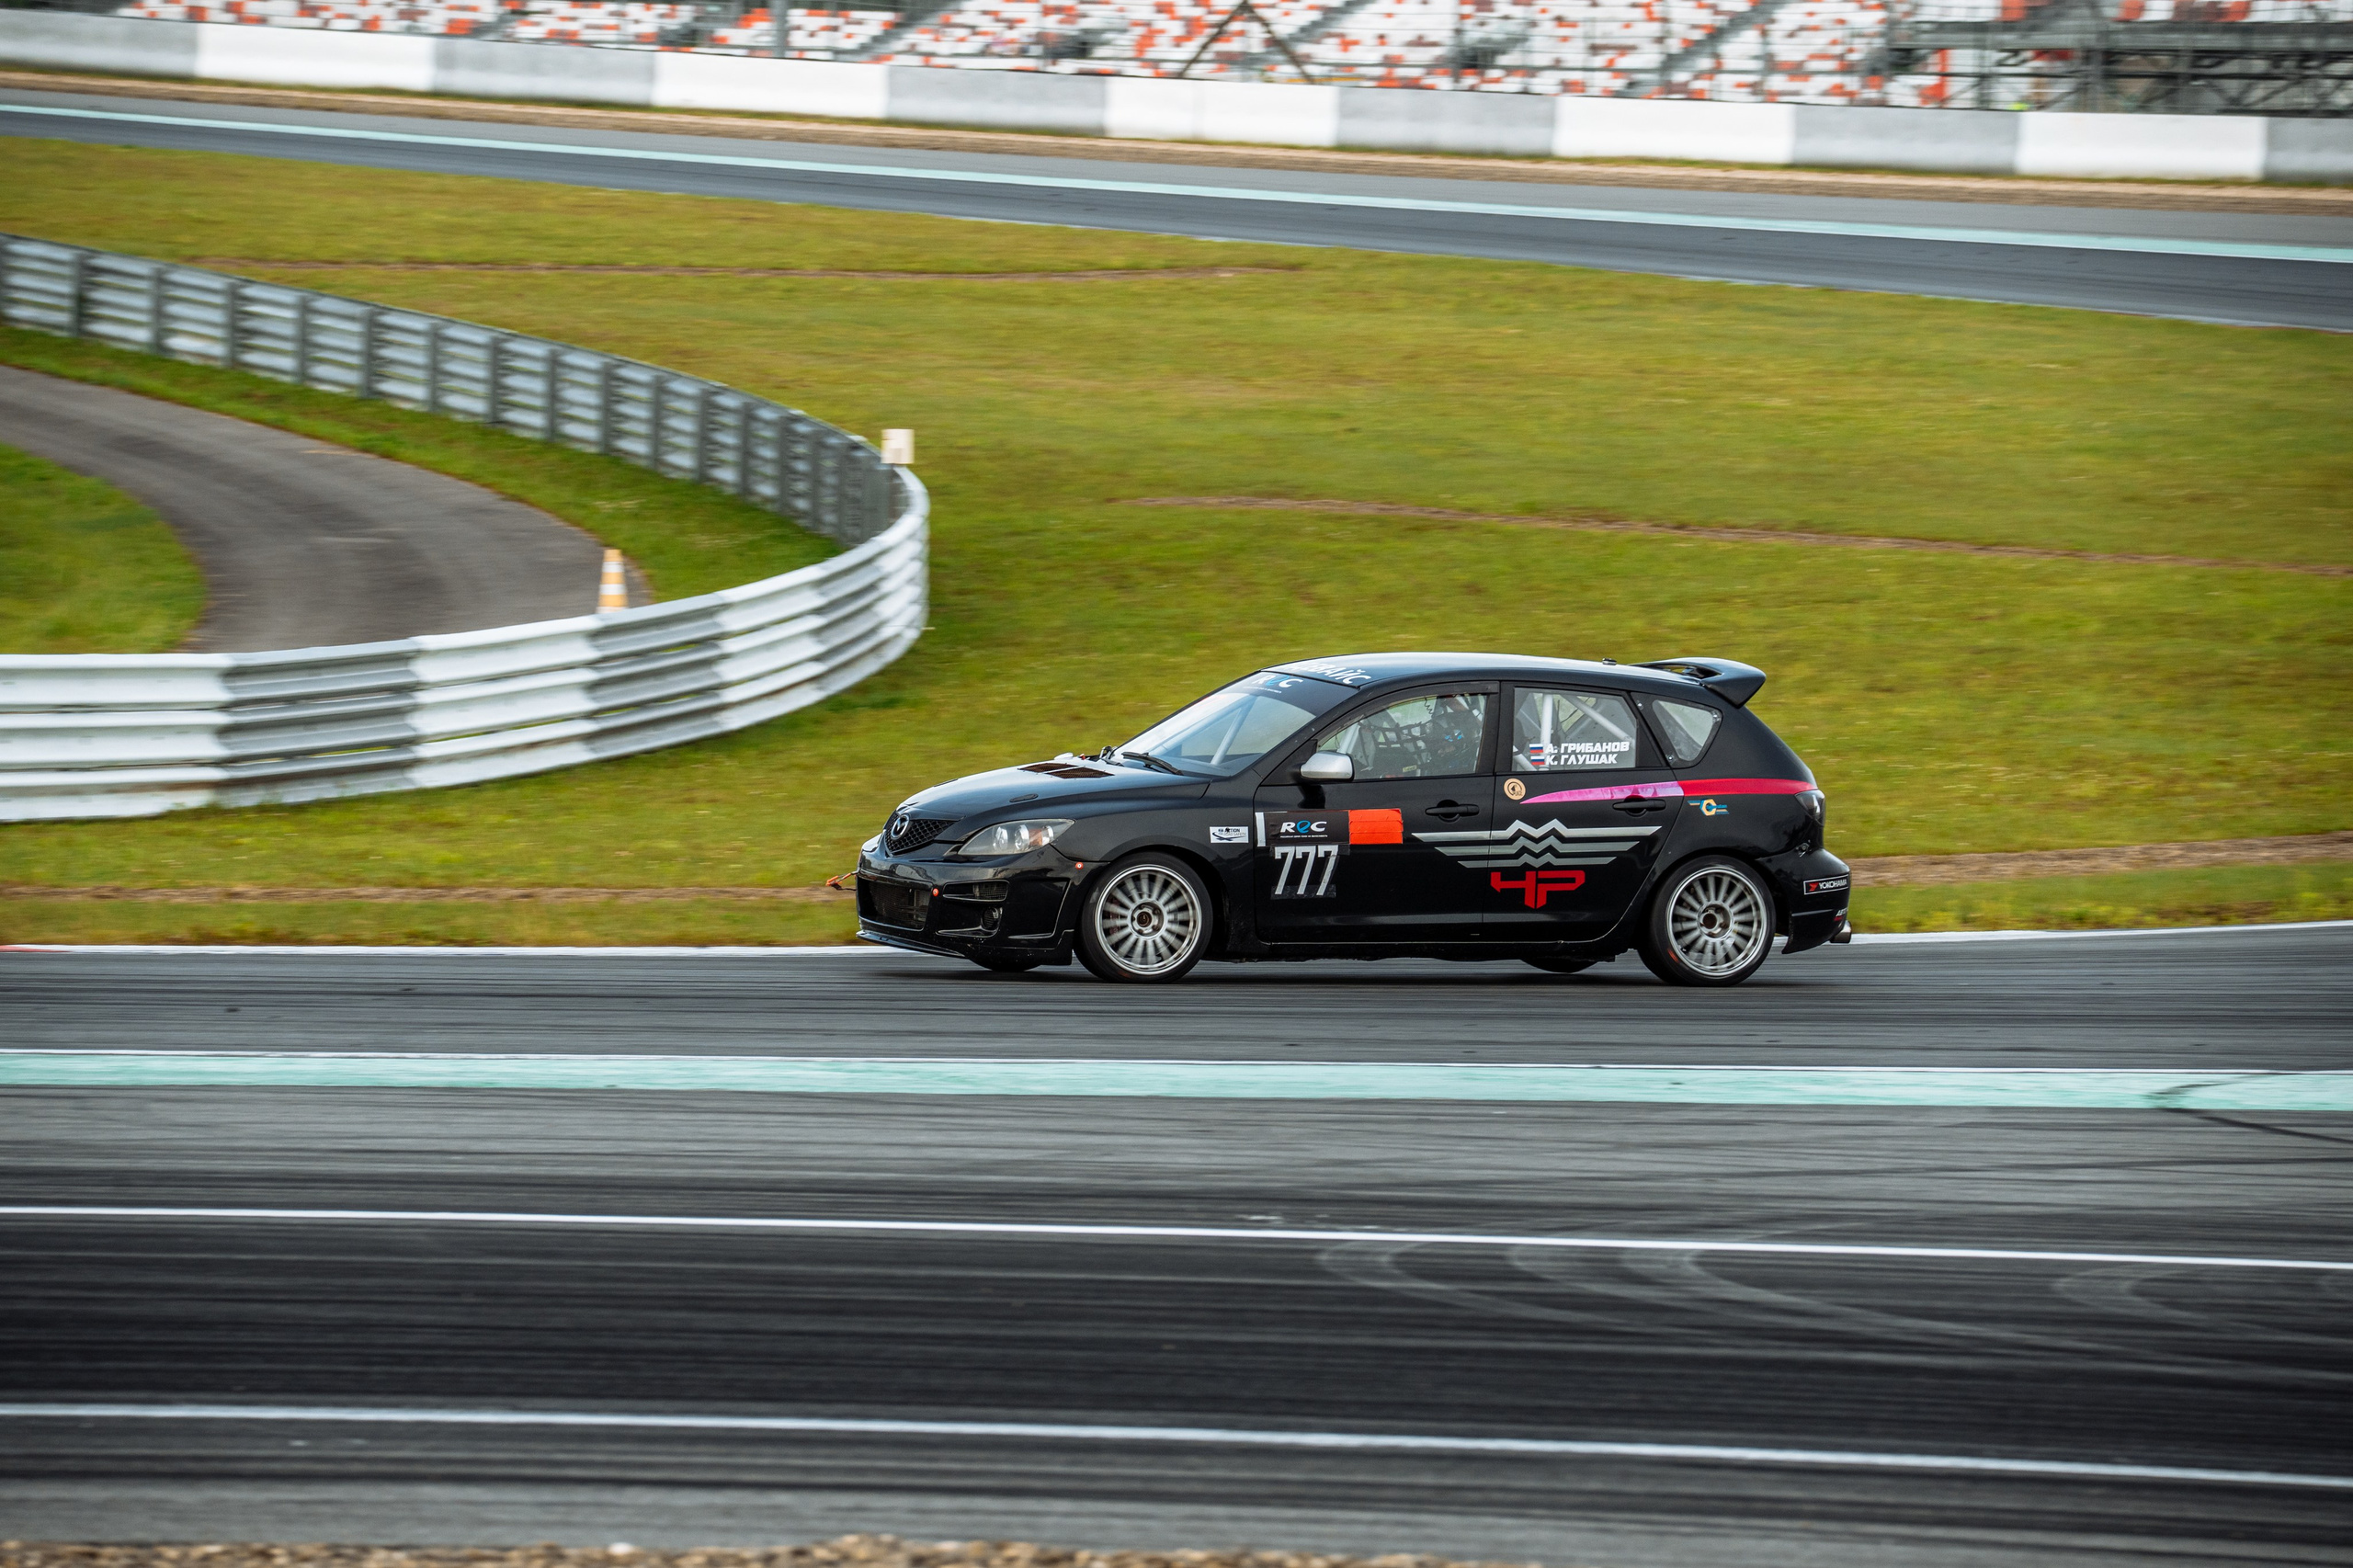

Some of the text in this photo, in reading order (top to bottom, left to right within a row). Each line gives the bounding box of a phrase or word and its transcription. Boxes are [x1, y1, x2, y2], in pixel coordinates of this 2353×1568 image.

[1561, 742, 1630, 754] ГРИБАНОВ
[1561, 754, 1618, 765] ГЛУШАК
[1275, 845, 1338, 895] 777
